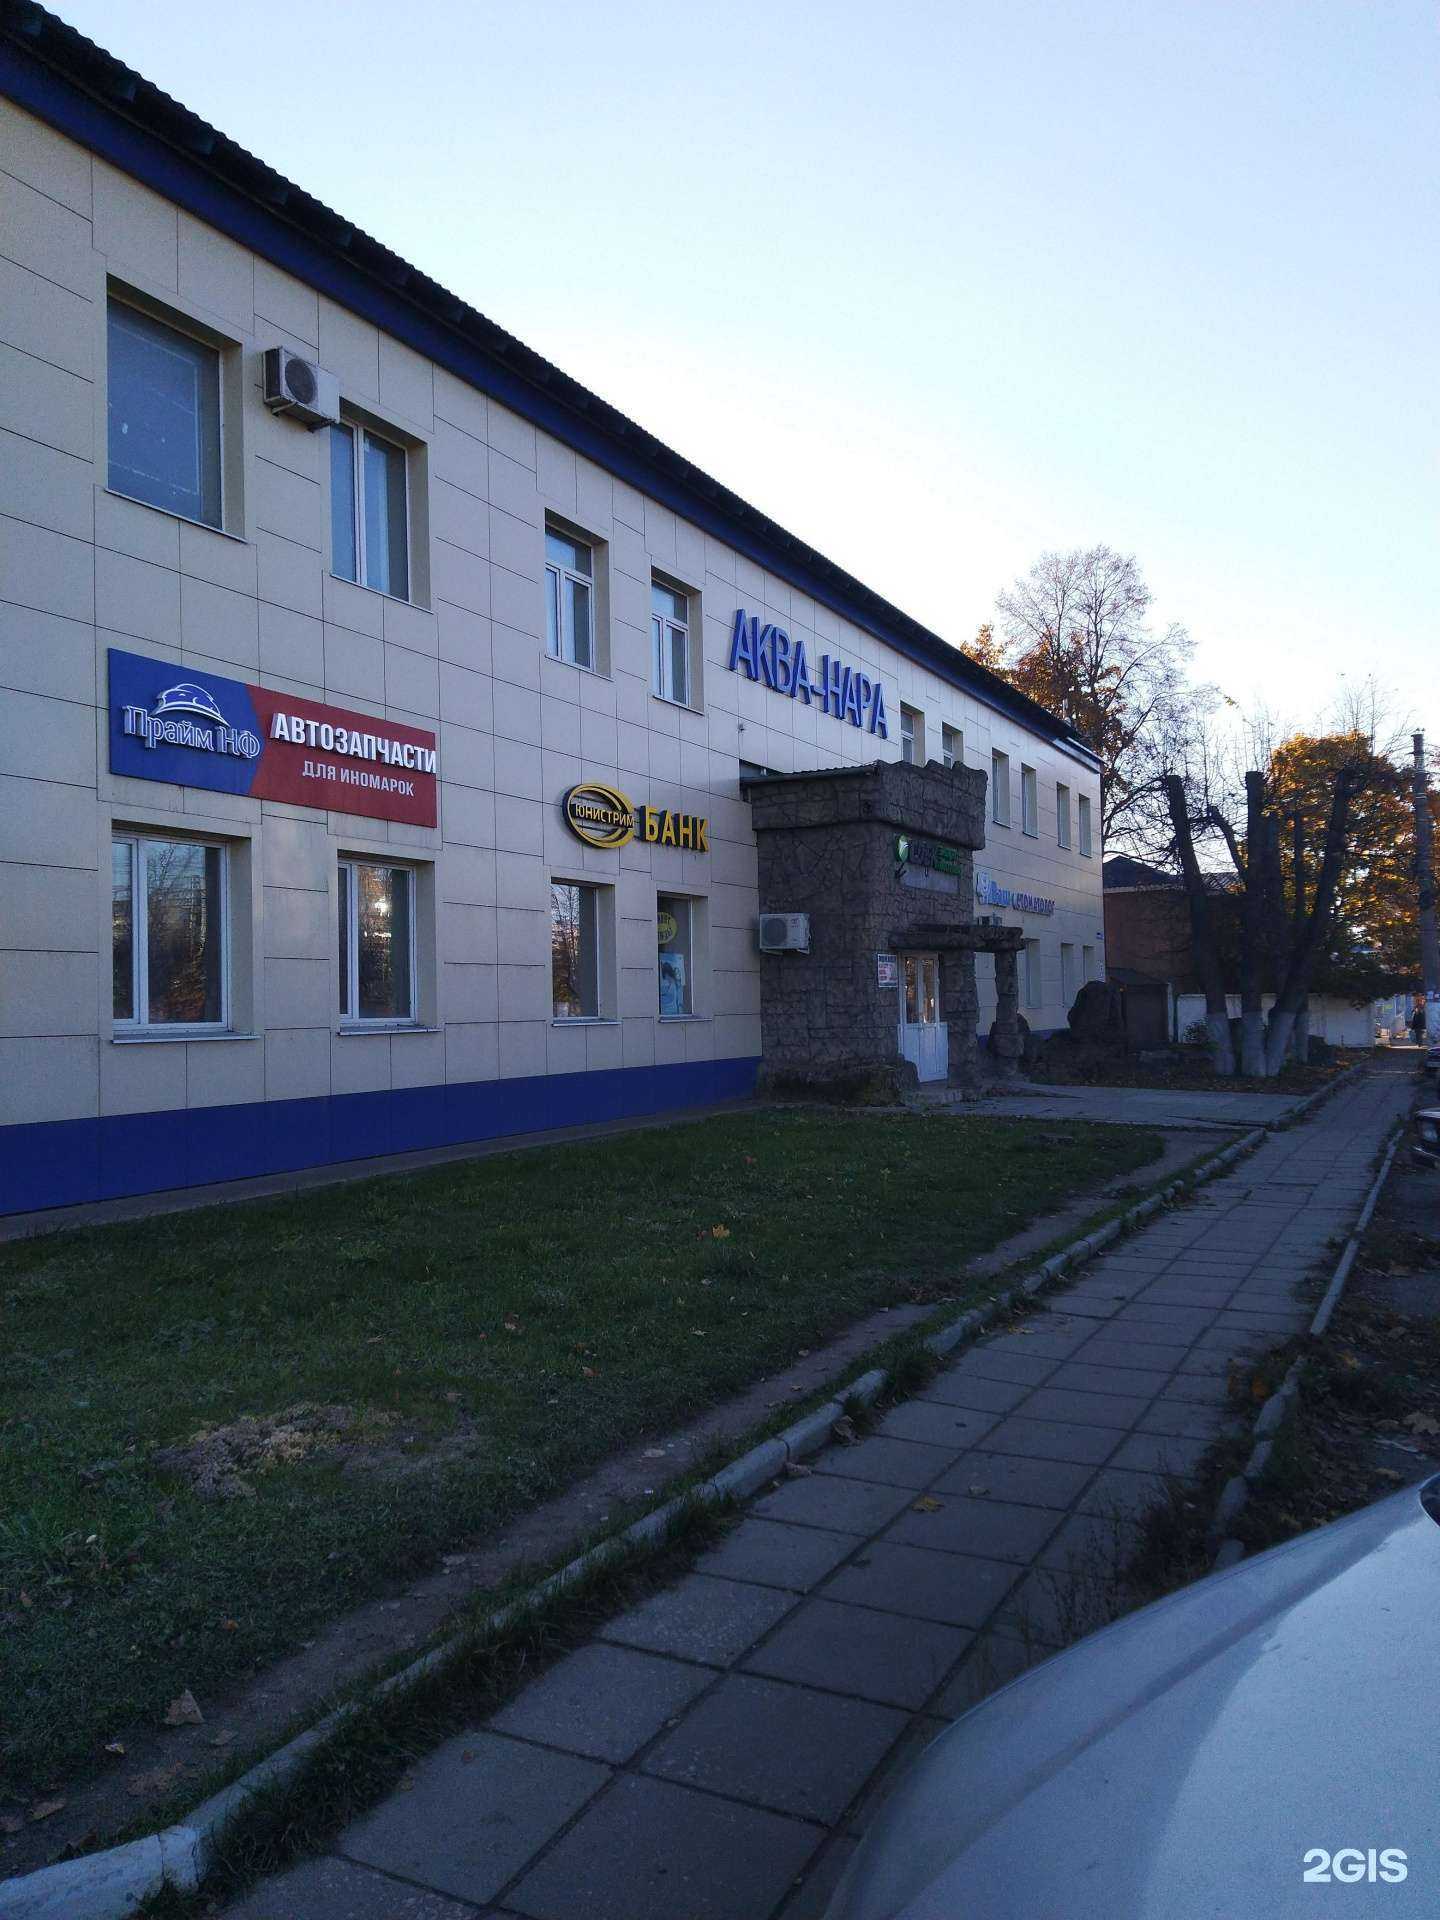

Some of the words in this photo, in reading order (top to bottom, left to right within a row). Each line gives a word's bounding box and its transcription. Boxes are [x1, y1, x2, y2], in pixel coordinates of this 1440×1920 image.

[729, 608, 888, 739] АКВА-НАРА
[123, 705, 214, 752] Прайм
[217, 726, 262, 760] НФ
[270, 712, 437, 774] АВТОЗАПЧАСТИ
[302, 760, 337, 781] ДЛЯ
[340, 768, 414, 797] ИНОМАРОК
[575, 804, 634, 829] ЮНИСТРИМ
[640, 805, 709, 852] БАНК
